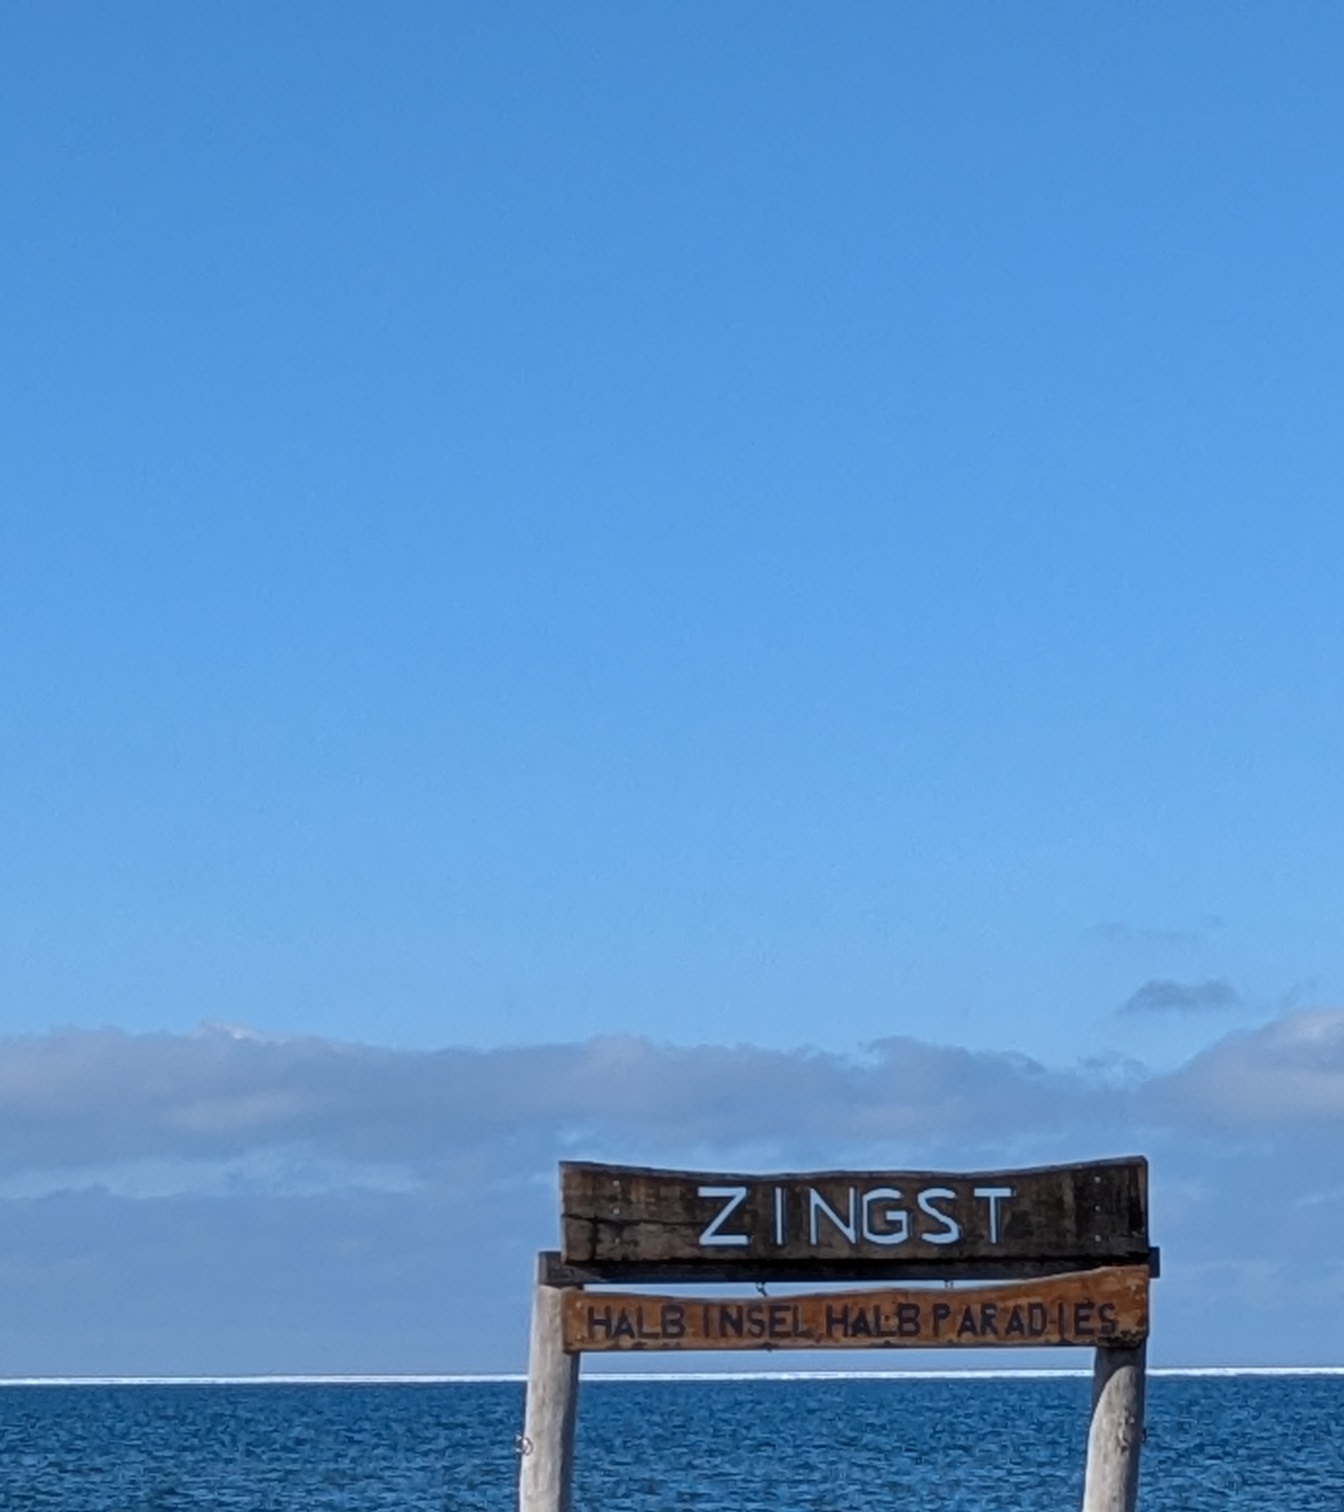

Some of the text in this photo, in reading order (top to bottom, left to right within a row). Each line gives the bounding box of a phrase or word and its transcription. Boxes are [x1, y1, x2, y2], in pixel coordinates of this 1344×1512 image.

[697, 1186, 1012, 1245] ZINGST
[587, 1305, 685, 1339] HALB
[825, 1303, 920, 1338] HALB
[932, 1302, 1117, 1337] PARADIES
